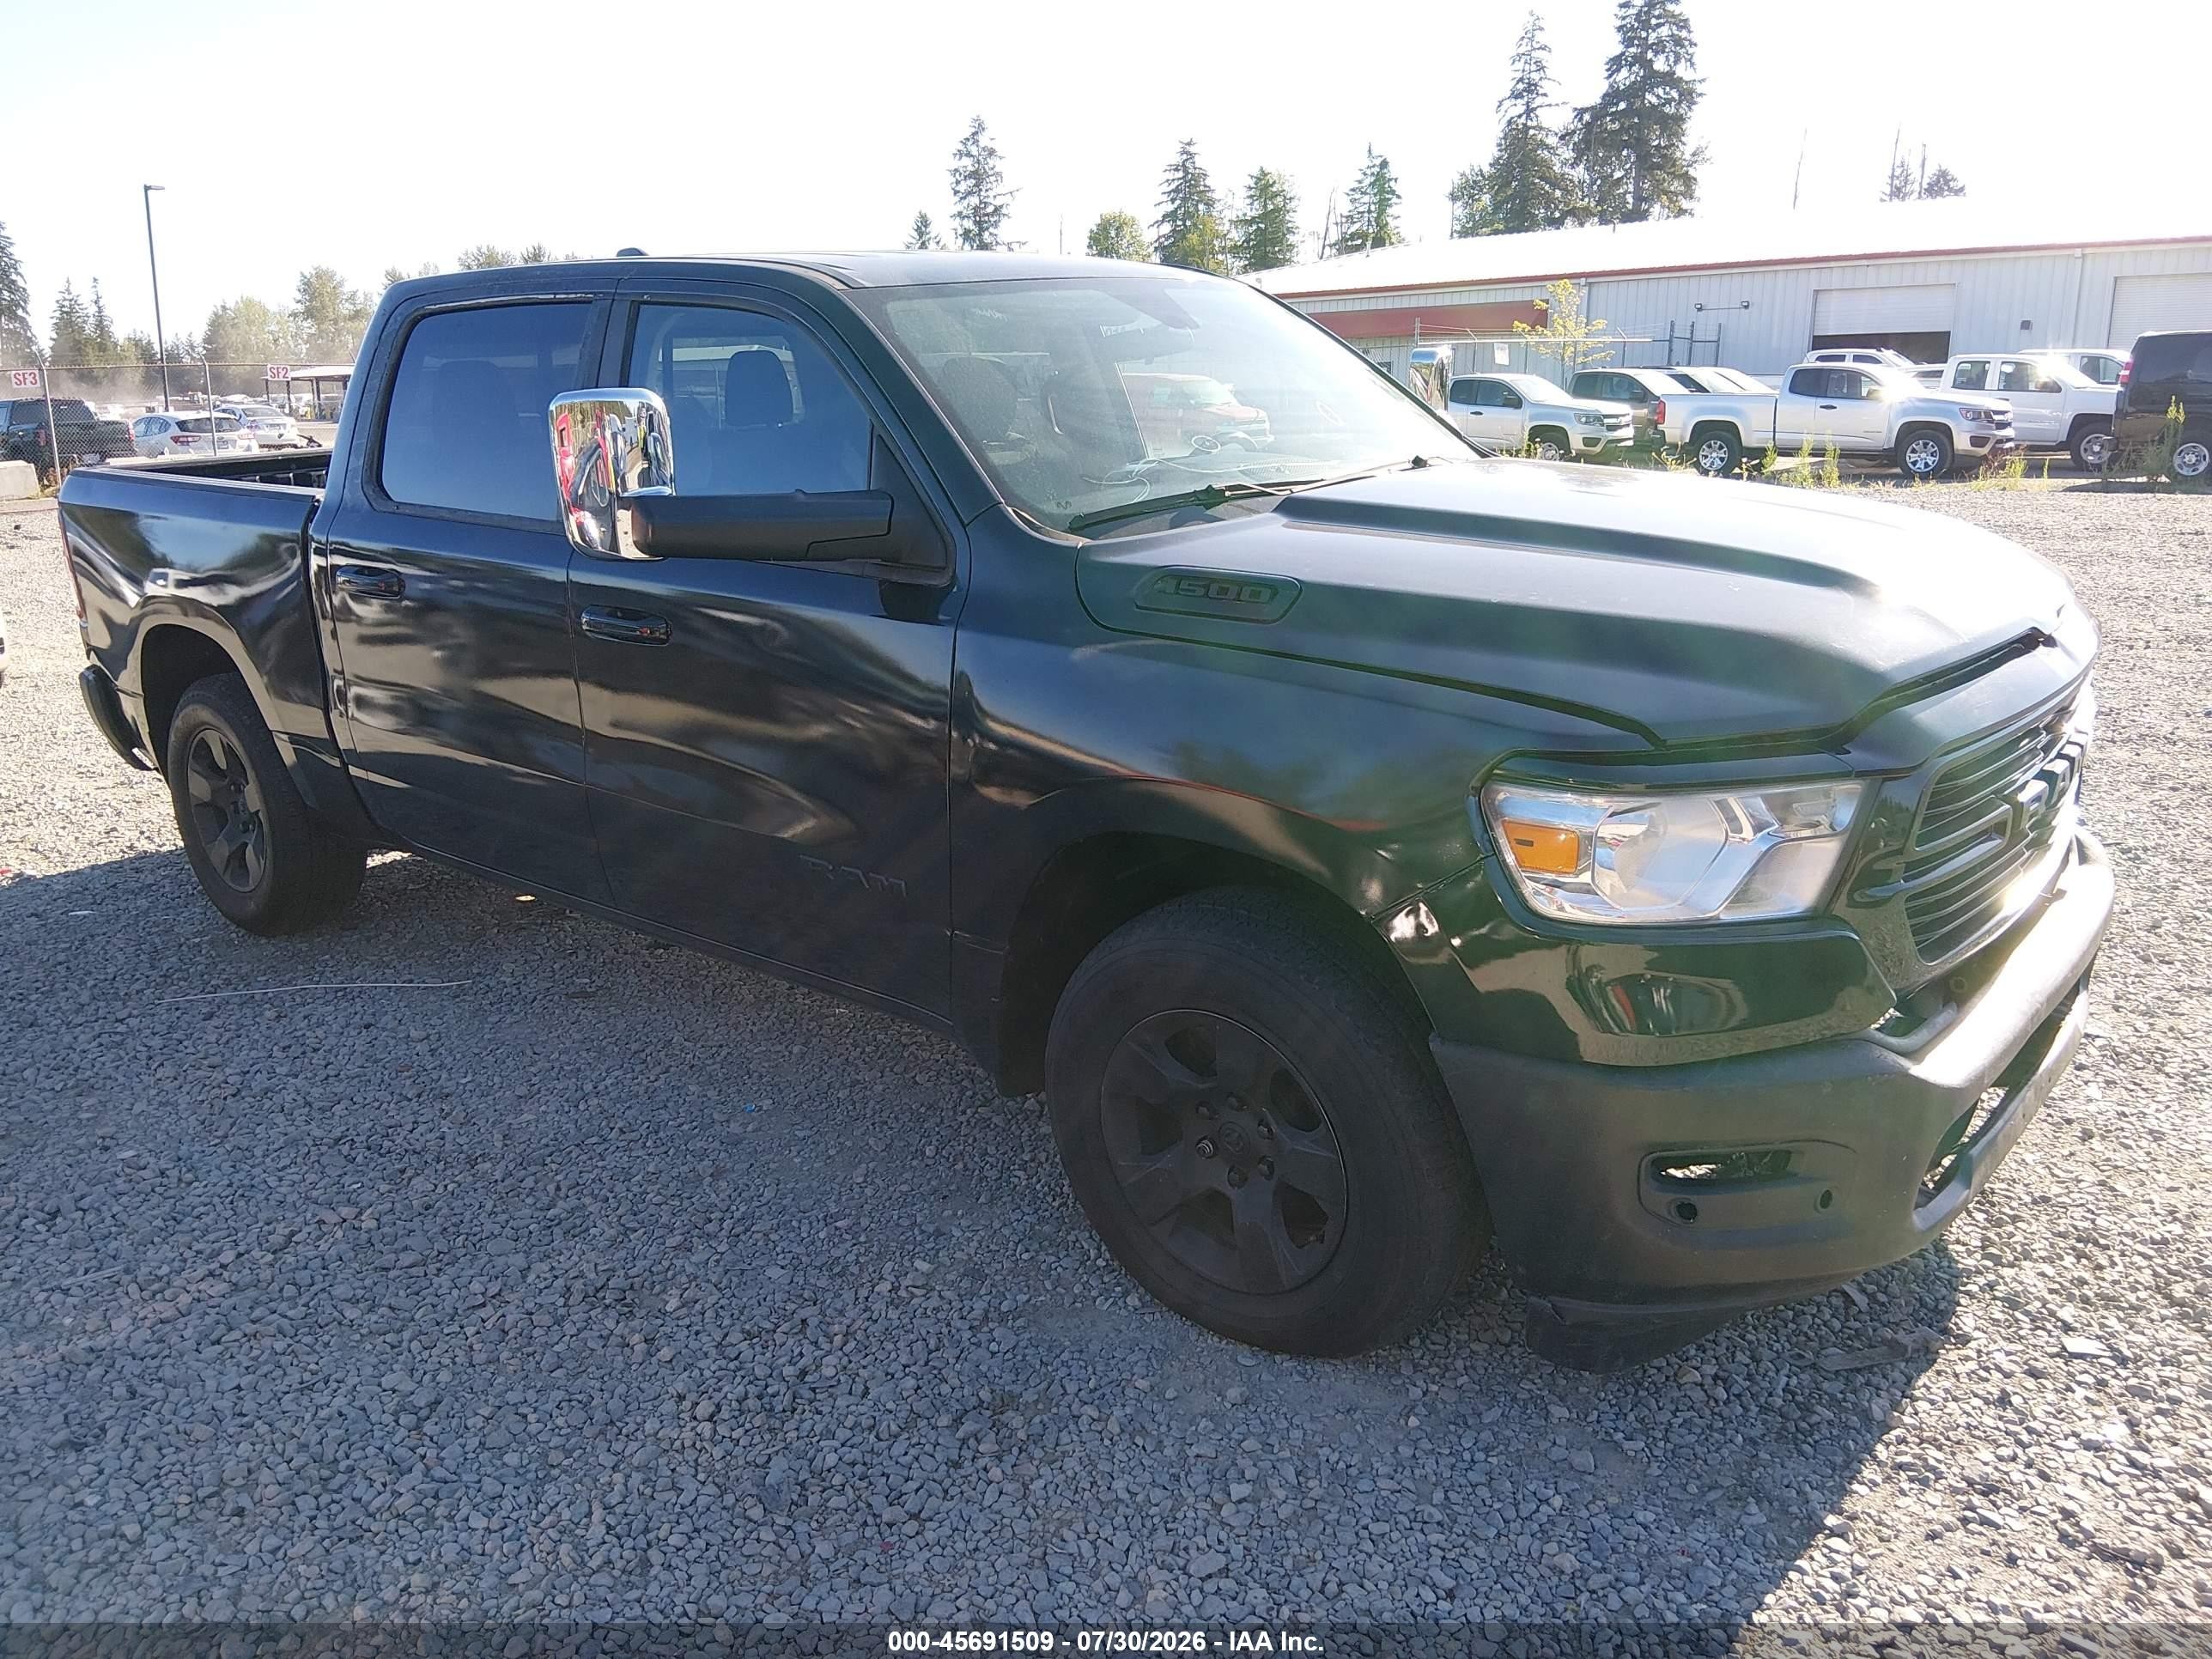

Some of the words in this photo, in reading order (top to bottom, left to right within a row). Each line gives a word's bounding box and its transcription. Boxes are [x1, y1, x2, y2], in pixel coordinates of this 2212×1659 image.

[13, 372, 38, 386] SF3
[269, 367, 289, 379] SF2
[1151, 575, 1273, 605] 1500
